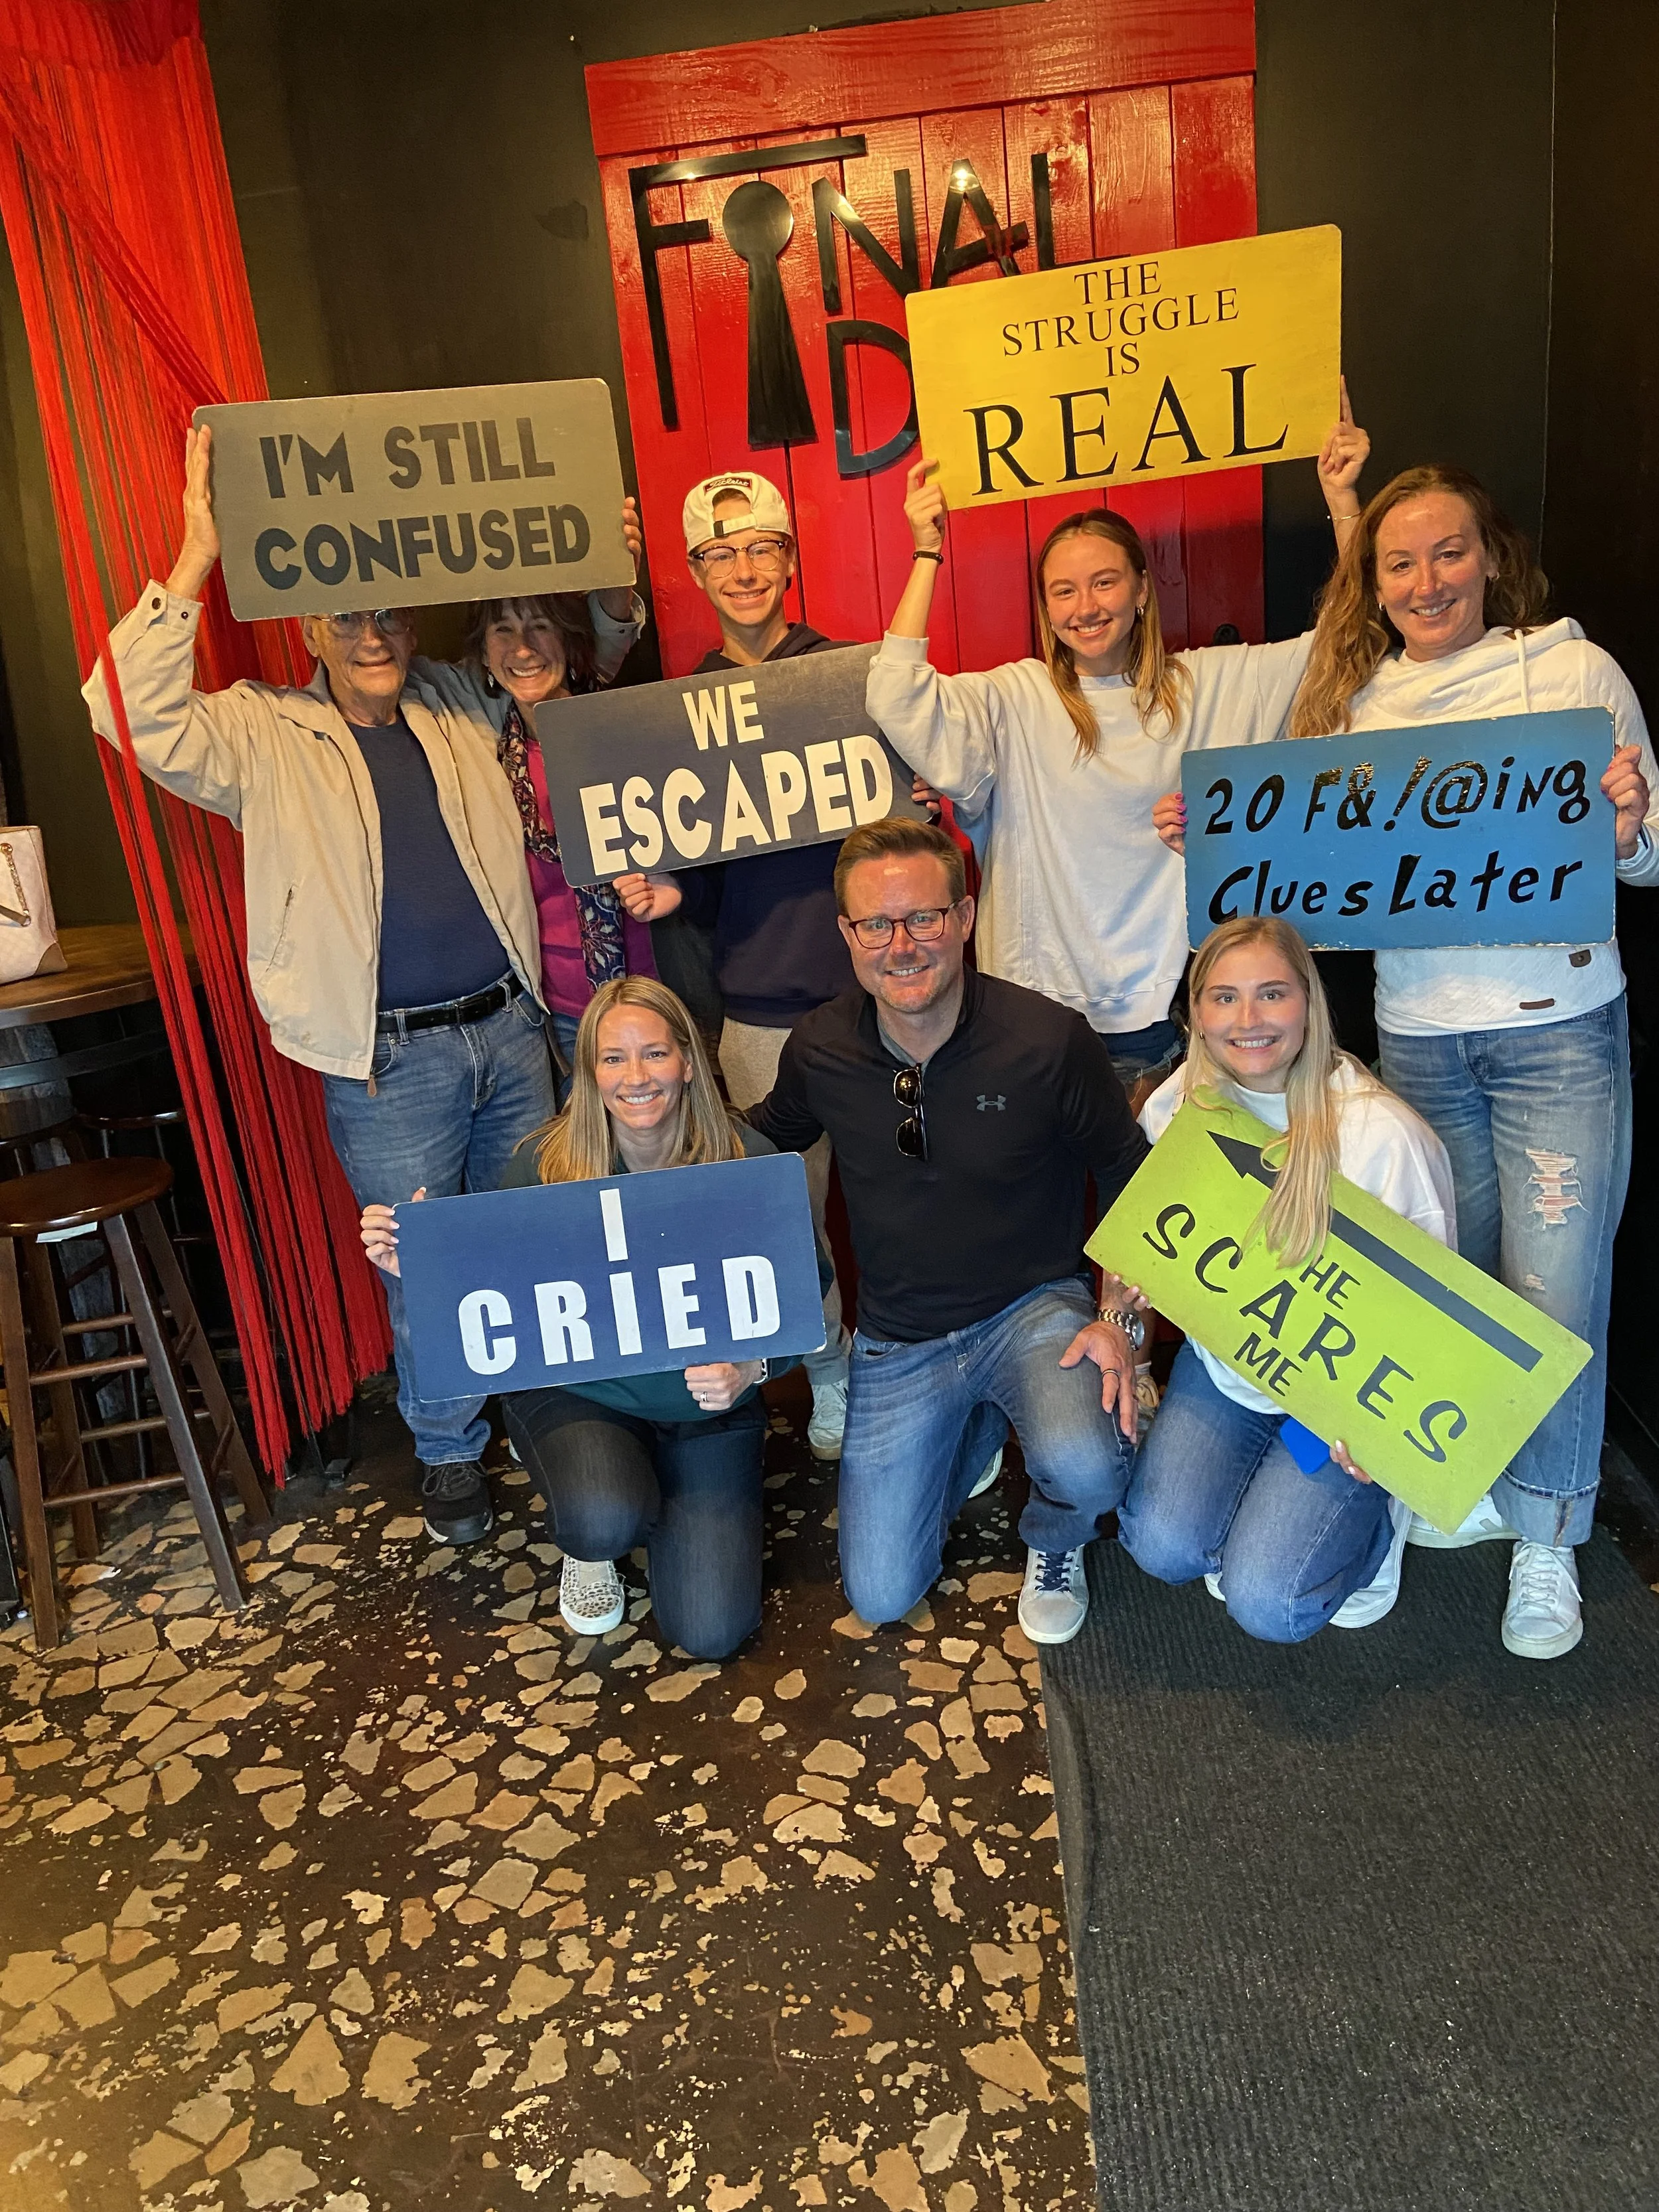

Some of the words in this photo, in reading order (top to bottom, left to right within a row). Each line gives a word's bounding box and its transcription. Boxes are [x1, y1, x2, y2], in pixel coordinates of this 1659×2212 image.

[1074, 261, 1161, 305] THE
[1002, 287, 1239, 357] STRUGGLE
[1106, 342, 1140, 378] IS
[259, 431, 354, 499] I'M
[384, 417, 555, 490] STILL
[963, 363, 1289, 496] REAL
[254, 504, 590, 590] CONFUSED
[682, 680, 764, 751] WE
[579, 734, 893, 877] ESCAPED
[1204, 774, 1285, 836] 20
[1208, 859, 1374, 925] Clues
[1388, 850, 1583, 916] Later
[599, 1188, 629, 1262] I
[458, 1255, 781, 1376] CRIED
[1299, 1254, 1362, 1310] HE
[1142, 1203, 1468, 1463] SCARES
[1234, 1331, 1303, 1397] ME
